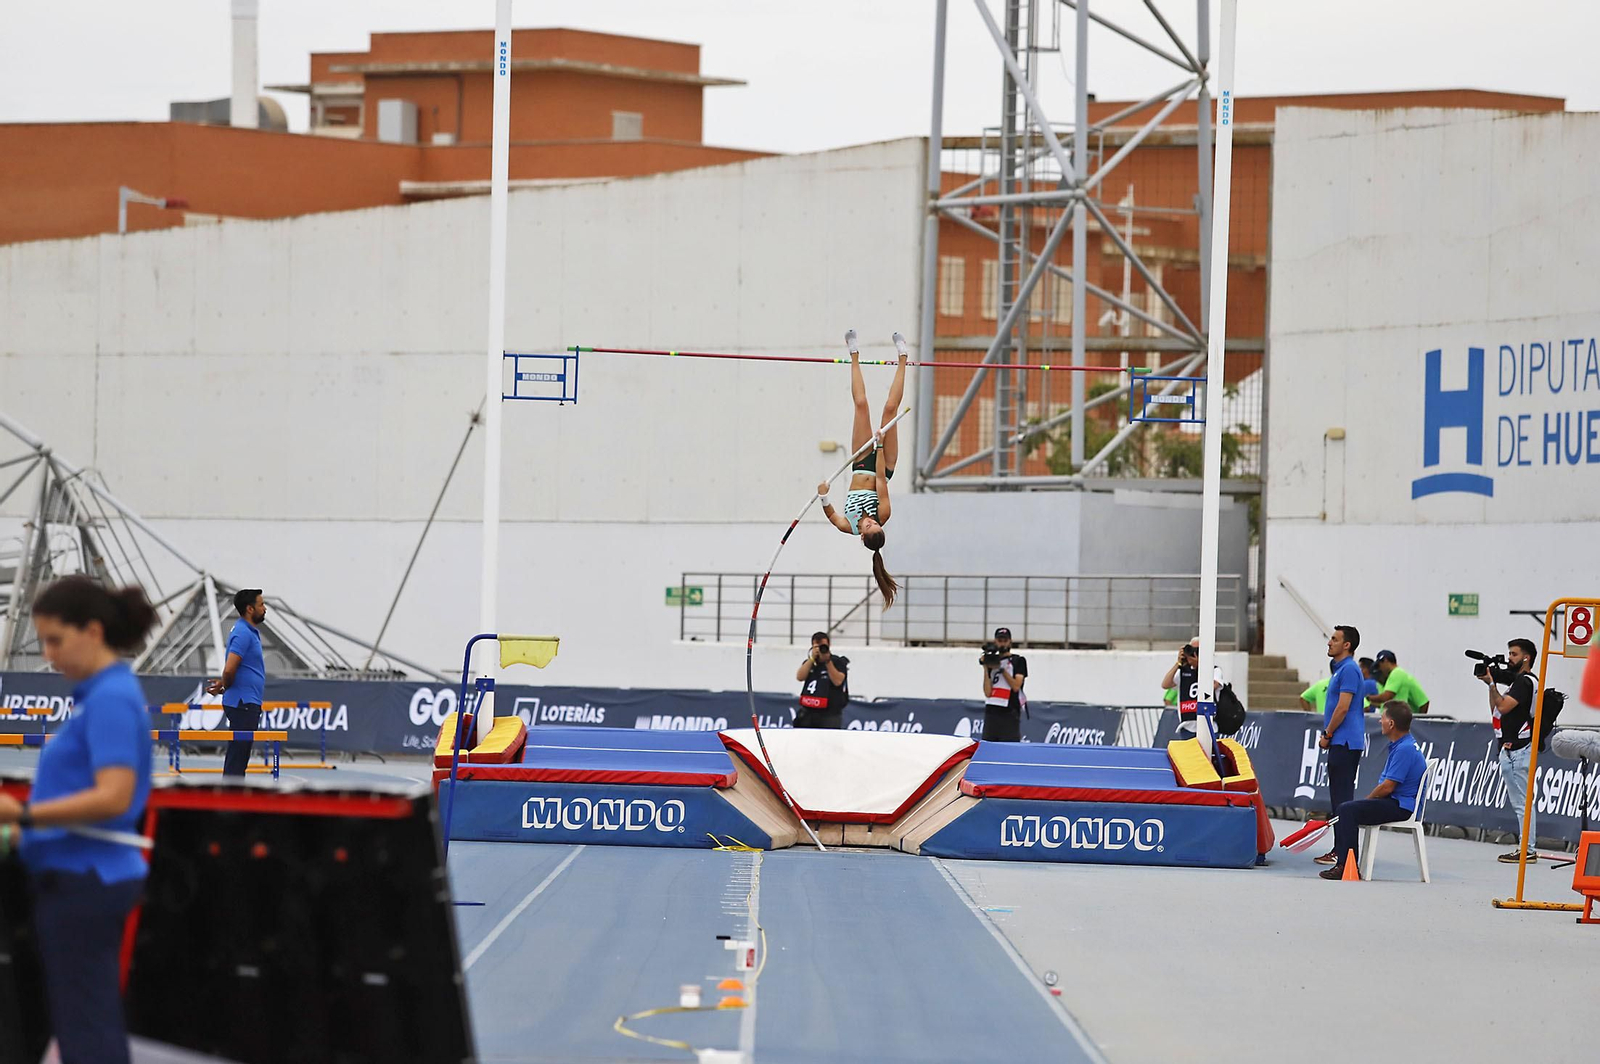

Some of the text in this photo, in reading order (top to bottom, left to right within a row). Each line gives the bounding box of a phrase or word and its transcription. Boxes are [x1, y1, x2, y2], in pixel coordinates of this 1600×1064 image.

[1222, 91, 1230, 125] MONDO
[522, 373, 558, 381] MONDO
[1498, 414, 1531, 467] DE
[1568, 607, 1593, 645] 8
[807, 680, 818, 694] 4
[541, 703, 605, 724] LOTERÍAS
[522, 797, 685, 833] MONDO
[1001, 815, 1165, 852] MONDO
